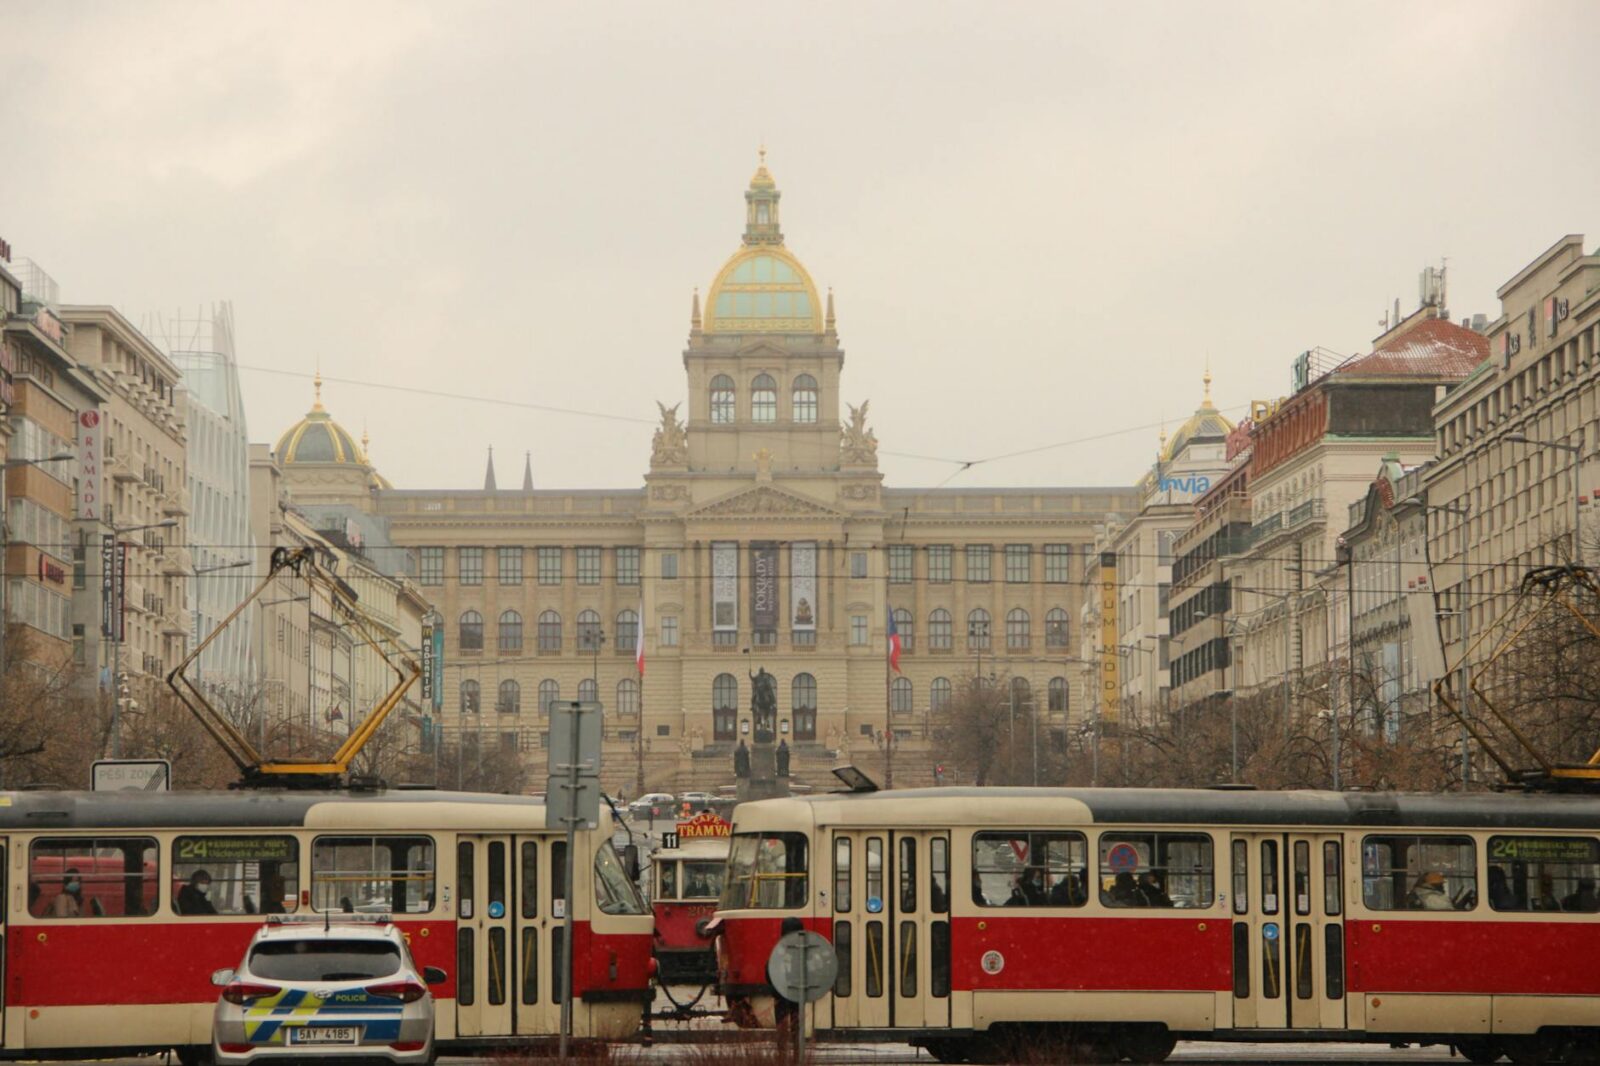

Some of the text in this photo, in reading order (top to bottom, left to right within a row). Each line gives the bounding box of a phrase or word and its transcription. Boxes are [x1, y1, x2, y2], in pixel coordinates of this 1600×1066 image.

[83, 436, 96, 518] RAMADA
[1159, 472, 1210, 494] invia
[678, 825, 729, 837] TRAMVA
[666, 833, 677, 848] 11
[1493, 839, 1518, 857] 24
[180, 840, 207, 858] 24
[335, 993, 368, 1002] POLICIE
[300, 1027, 350, 1040] 5AY 4185
